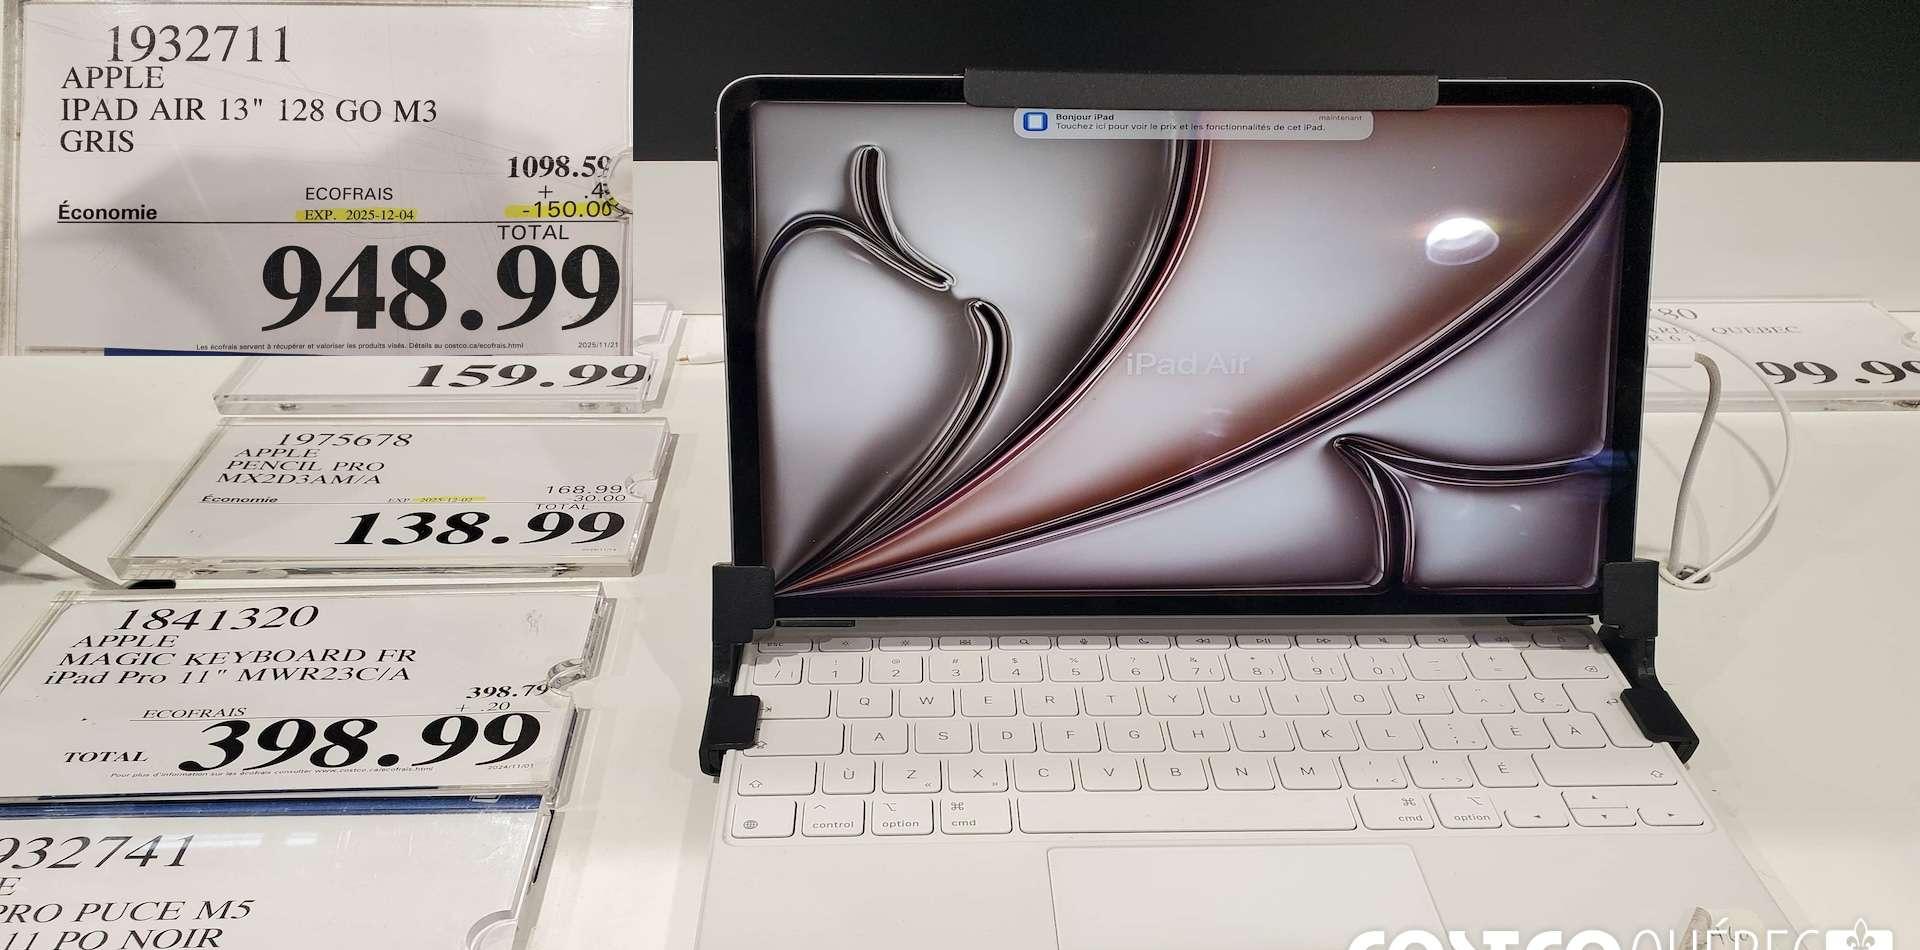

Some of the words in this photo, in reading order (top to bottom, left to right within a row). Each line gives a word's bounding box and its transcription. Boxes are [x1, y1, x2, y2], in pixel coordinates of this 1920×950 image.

[108, 25, 290, 62] 1932711
[61, 66, 164, 88] APPLE
[62, 99, 137, 120] IPAD
[149, 98, 206, 120] AIR
[221, 98, 262, 120] 13"
[280, 99, 324, 121] 128
[336, 100, 381, 122] GO
[394, 100, 436, 122] M3
[1056, 113, 1092, 122] Bonjour
[1094, 113, 1115, 121] iPad
[1056, 122, 1094, 130] Touchez
[1109, 124, 1130, 132] pour
[1161, 123, 1178, 132] prix
[1206, 123, 1271, 131] fonctionnalités
[61, 130, 133, 152] GRIS
[306, 187, 393, 200] ECOFRAIS
[58, 200, 157, 220] Économie
[306, 210, 336, 220] EXP.
[347, 210, 414, 220] 2025-12-04
[522, 200, 612, 218] -150.00
[497, 225, 569, 240] TOTAL
[262, 245, 620, 331] 948.99
[388, 342, 408, 350] visés.
[1126, 352, 1197, 376] iPad
[1205, 353, 1251, 375] Air
[408, 364, 648, 387] 159.99
[278, 433, 413, 447] 1975678
[235, 448, 320, 458] APPLE
[226, 461, 322, 471] PENCIL
[333, 462, 384, 471] PRO
[216, 473, 381, 485] MX2D3AM/A
[547, 485, 622, 495] 168.99
[202, 494, 279, 504] Économie
[335, 512, 624, 545] 138.99
[115, 606, 318, 630] 1841320
[72, 635, 179, 647] APPLE
[59, 653, 176, 665] MAGIC
[184, 649, 367, 666] KEYBOARD
[378, 650, 415, 662] FR
[44, 671, 109, 685] iPad
[116, 671, 167, 684] Pro
[179, 670, 228, 684] 11"
[238, 667, 409, 681] MWR23C/A
[891, 669, 901, 678] 2
[951, 669, 961, 677] 3
[1012, 668, 1021, 676] 4
[466, 684, 549, 699] 398.79
[859, 697, 870, 706] Q
[919, 696, 934, 705] W
[983, 695, 993, 705] E
[1045, 695, 1055, 704] R
[1105, 694, 1118, 704] T
[1168, 695, 1178, 703] Y
[1229, 695, 1241, 703] U
[1416, 693, 1425, 702] P
[143, 708, 246, 719] ECOFRAIS
[65, 752, 147, 762] TOTAL
[178, 713, 541, 772] 398.99
[873, 732, 885, 742] A
[938, 731, 949, 741] S
[1002, 731, 1013, 740] D
[1066, 730, 1074, 740] F
[1128, 730, 1140, 739] G
[1193, 729, 1204, 739] H
[1322, 729, 1333, 738] K
[906, 769, 917, 779] Z
[973, 769, 983, 778] X
[1038, 768, 1050, 778] C
[1103, 768, 1115, 777] V
[1170, 767, 1182, 777] B
[1236, 767, 1248, 776] N
[1301, 767, 1315, 776] M
[811, 819, 855, 830] control
[881, 818, 920, 831] option
[951, 817, 979, 828] cmd
[1398, 813, 1424, 824] cmd
[1453, 812, 1492, 825] option
[74, 902, 185, 922] PUCE
[195, 900, 255, 919] M5
[54, 931, 108, 950] PO
[121, 929, 223, 949] NOIR
